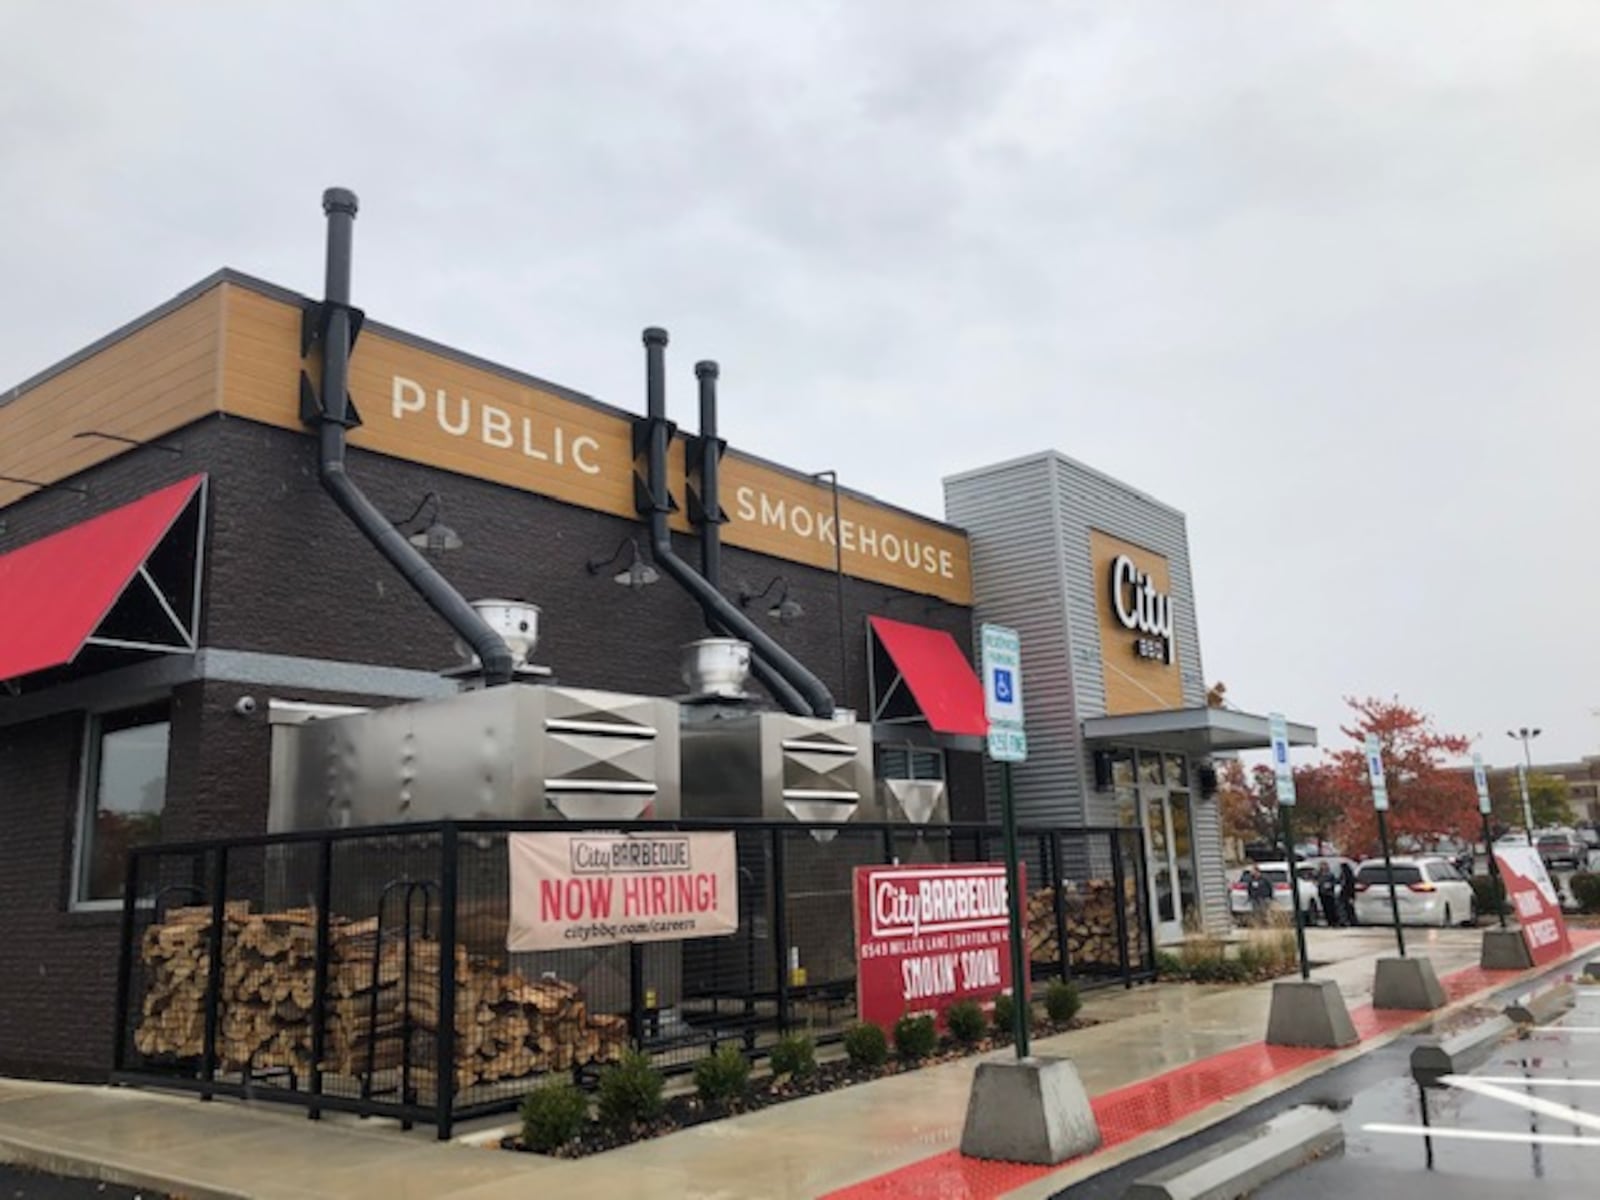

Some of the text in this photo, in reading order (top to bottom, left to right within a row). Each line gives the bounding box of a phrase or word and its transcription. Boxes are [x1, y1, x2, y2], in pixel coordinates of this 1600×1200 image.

[391, 375, 602, 475] PUBLIC
[736, 485, 955, 580] SMOKEHOUSE
[1112, 555, 1175, 665] City
[577, 842, 686, 874] City BARBEQUE
[540, 872, 718, 922] NOW HIRING!
[877, 876, 1010, 937] City BARBEQUE
[564, 919, 696, 940] citybbq.com/careers
[902, 947, 1001, 1000] SMOKIN' SOON!
